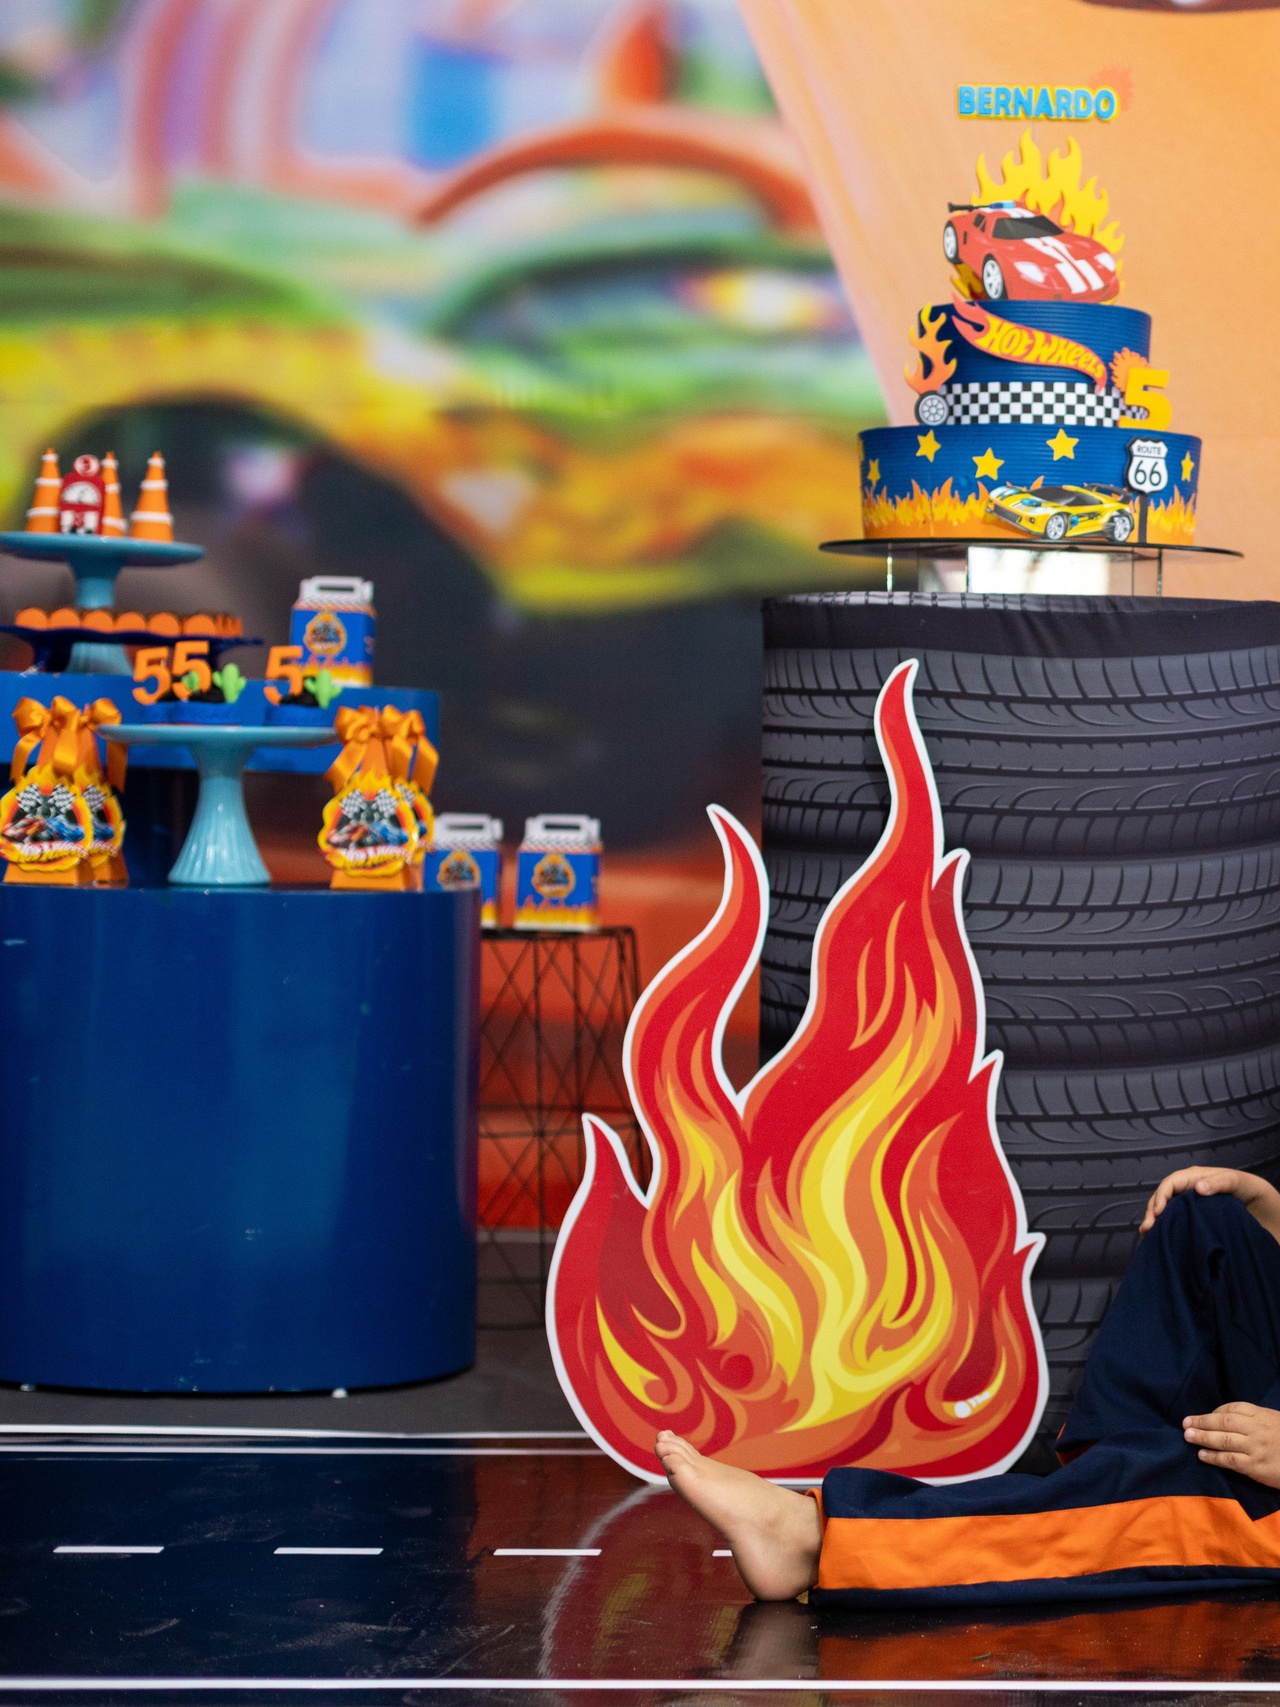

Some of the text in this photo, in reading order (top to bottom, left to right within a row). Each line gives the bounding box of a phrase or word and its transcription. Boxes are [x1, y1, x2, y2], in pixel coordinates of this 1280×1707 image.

[957, 85, 1116, 120] BERNARDO
[1118, 367, 1172, 432] 5
[1134, 459, 1163, 487] 66
[1136, 444, 1162, 456] ROUTE
[132, 646, 172, 706] 5
[171, 640, 213, 703] 5
[263, 645, 304, 706] 5
